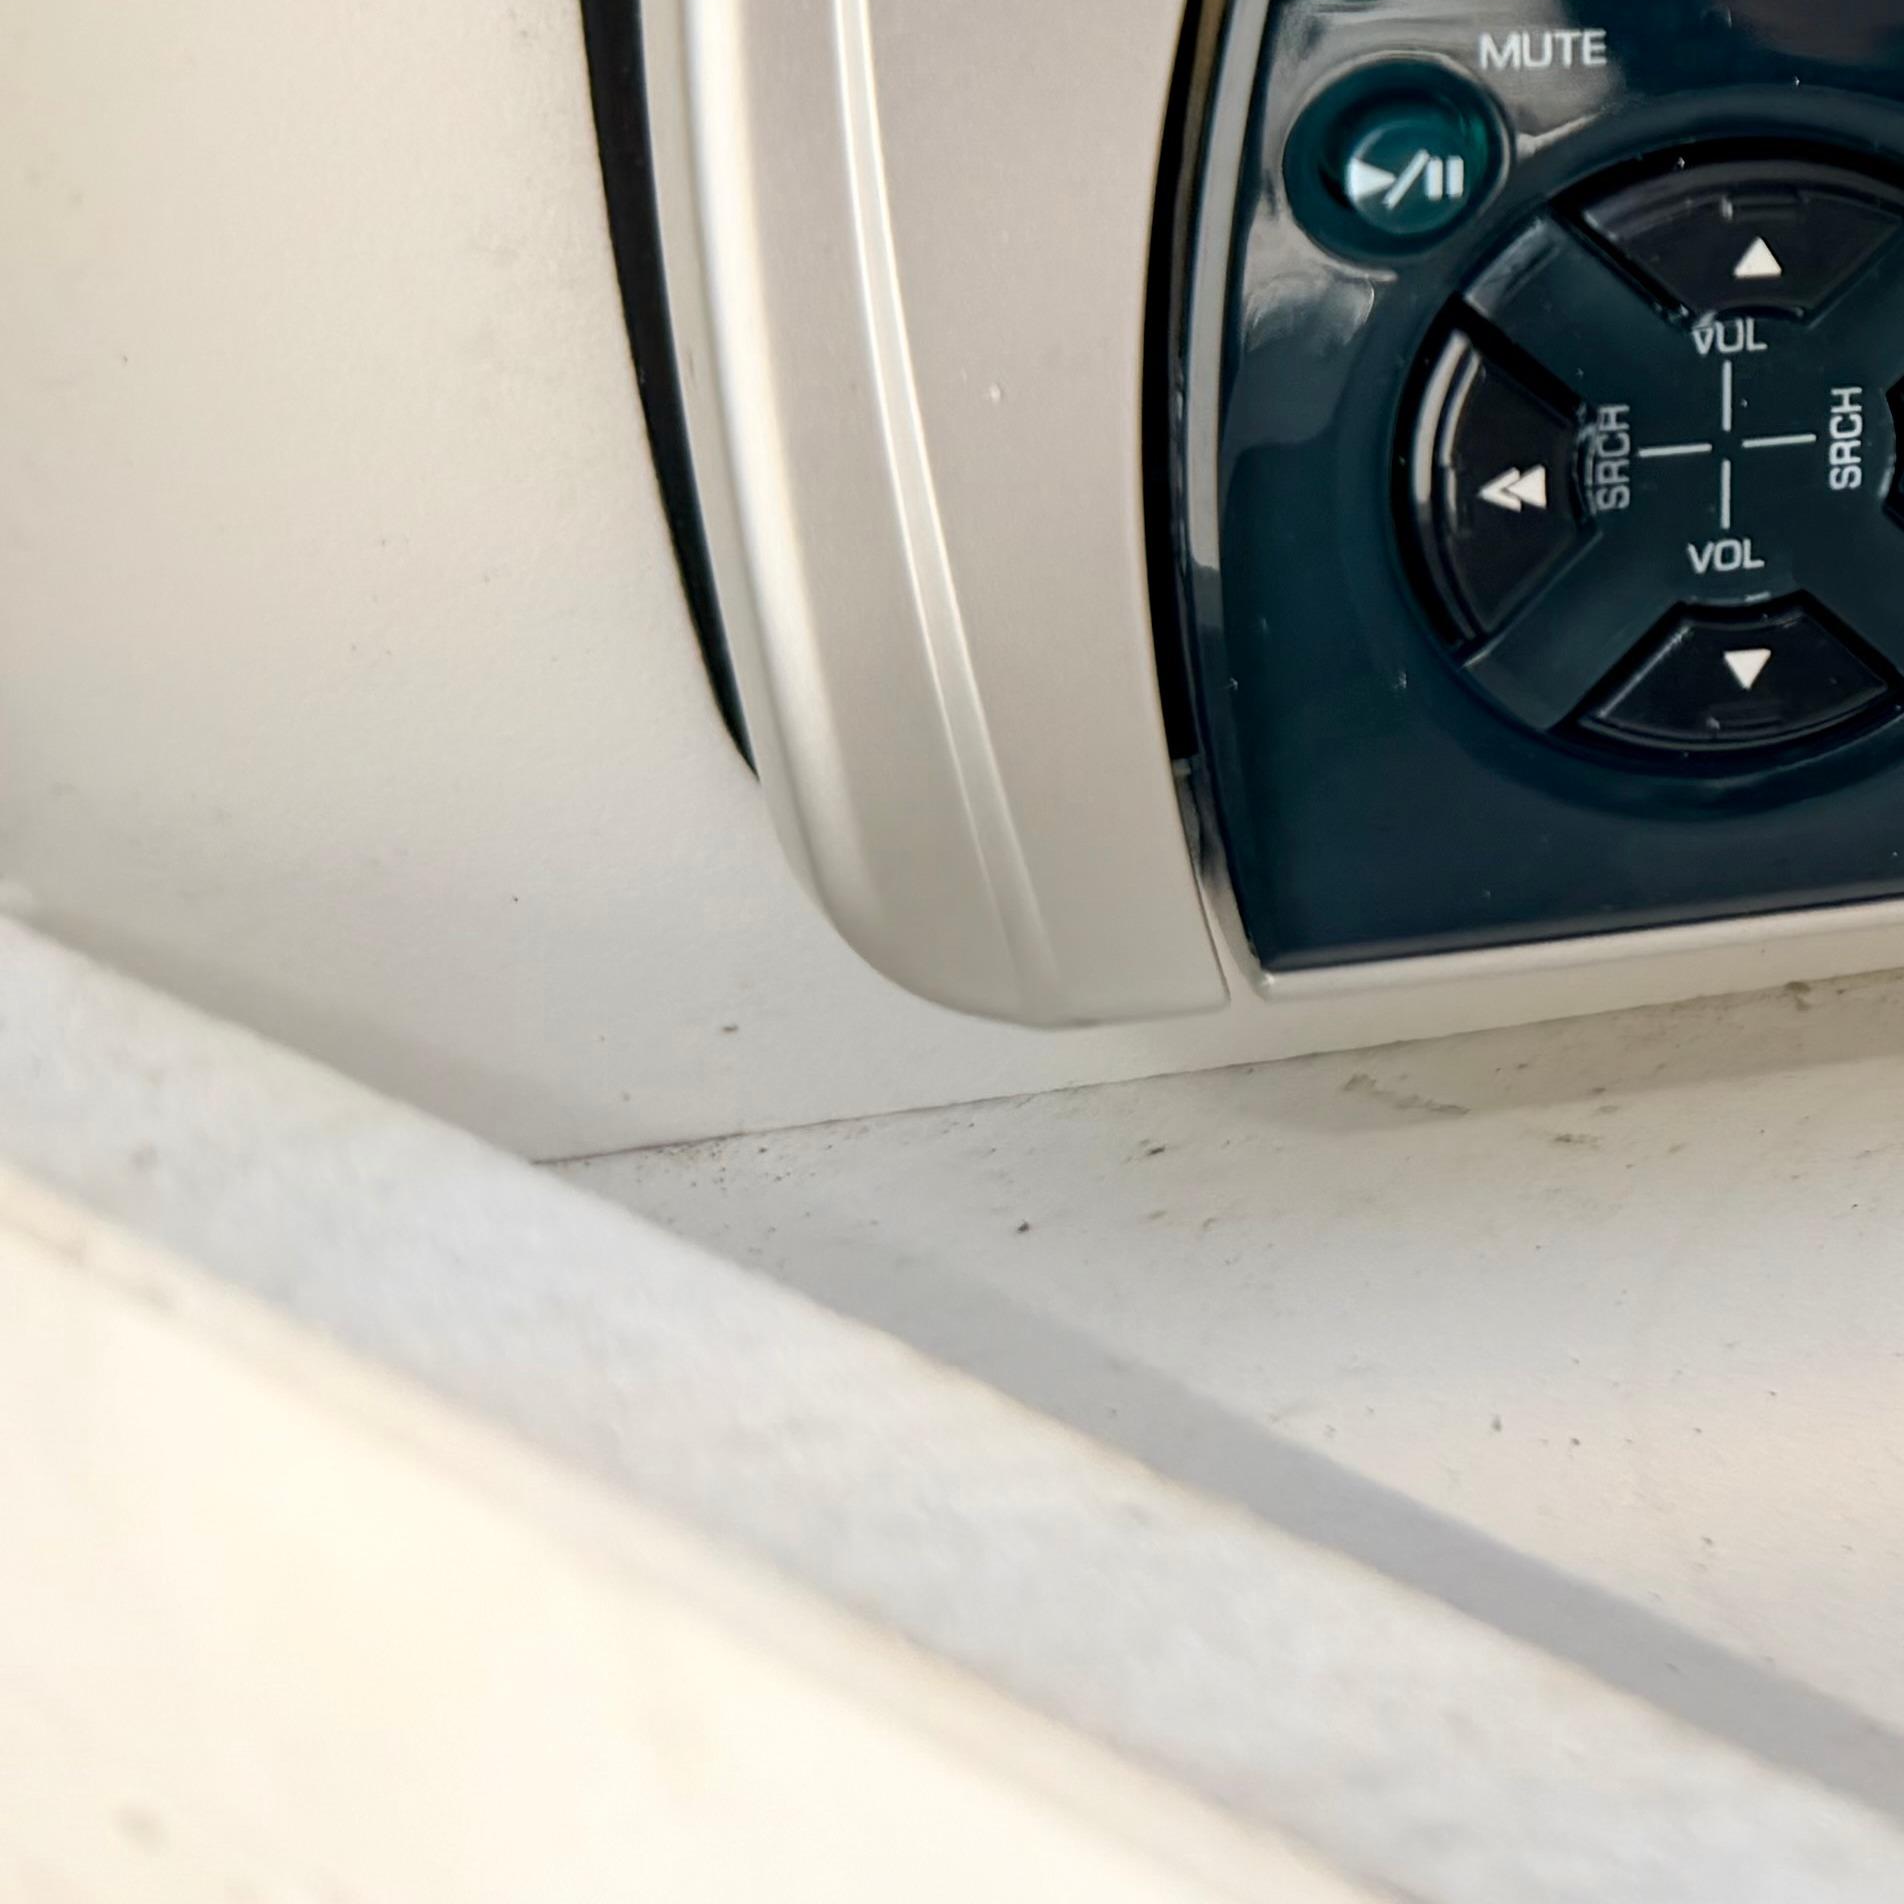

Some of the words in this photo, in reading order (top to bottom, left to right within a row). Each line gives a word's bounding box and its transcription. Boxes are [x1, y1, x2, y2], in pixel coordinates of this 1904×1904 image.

[1479, 29, 1608, 70] MUTE
[1692, 316, 1768, 355] VOL
[1595, 404, 1631, 512] SRCH
[1828, 386, 1863, 491] SRCH
[1687, 538, 1766, 575] VOL
